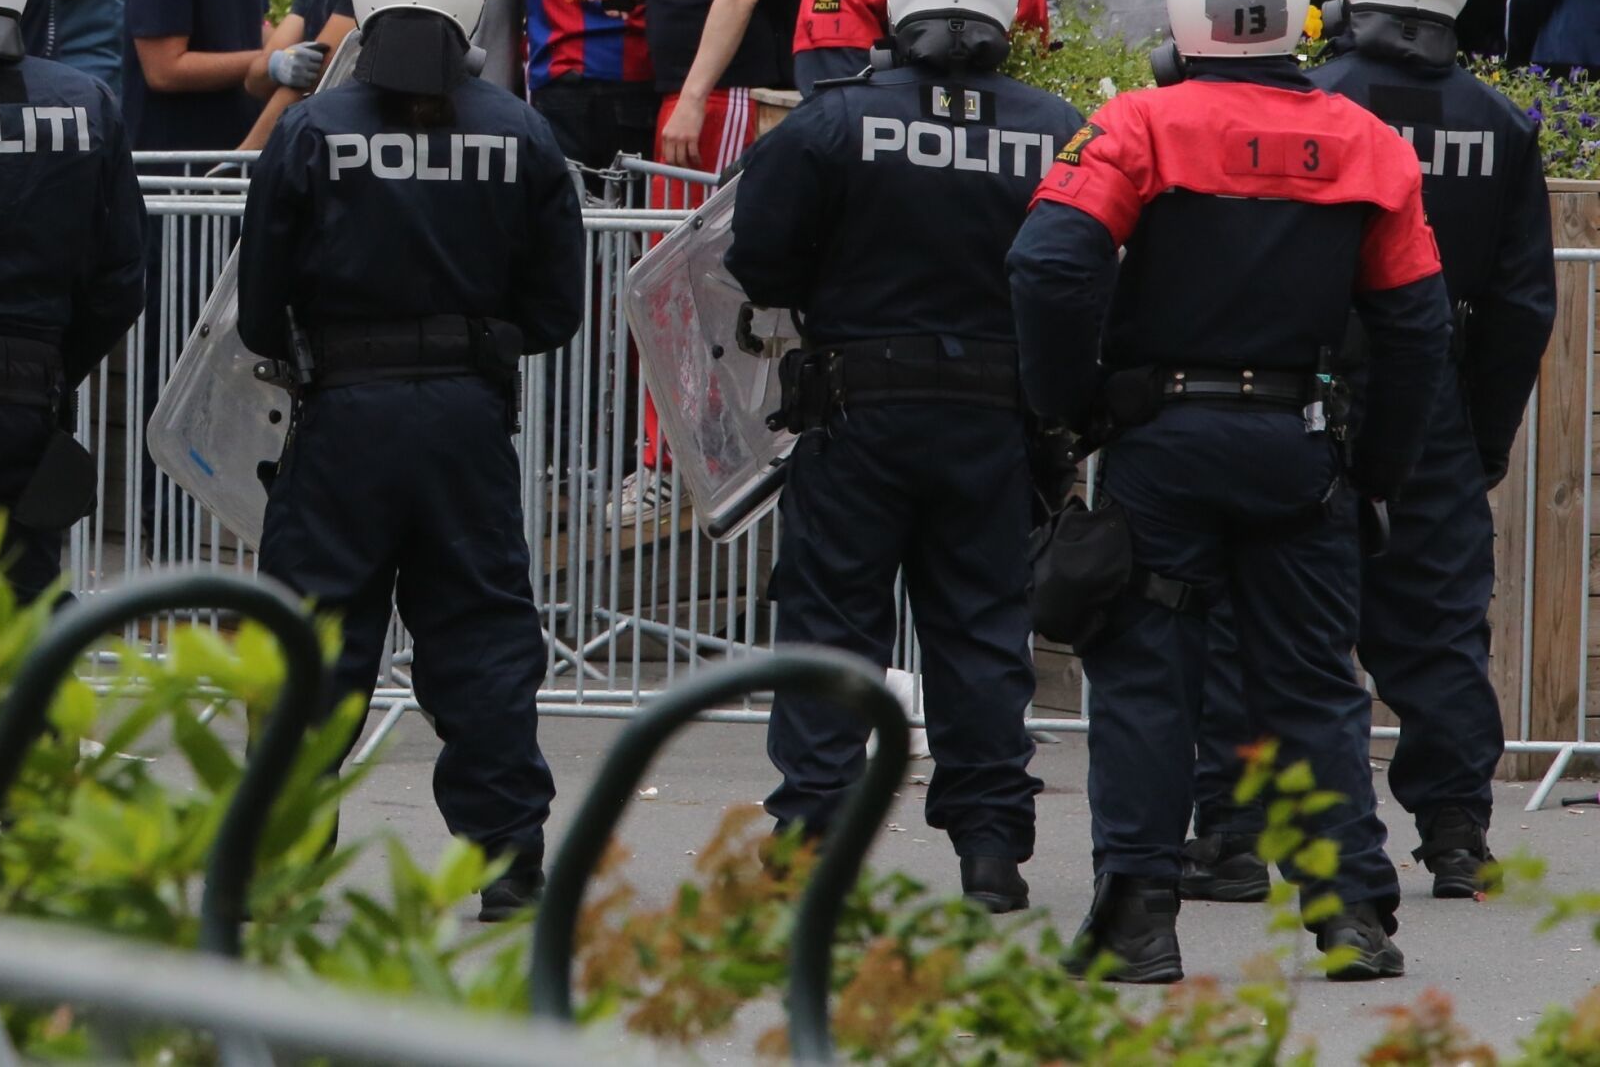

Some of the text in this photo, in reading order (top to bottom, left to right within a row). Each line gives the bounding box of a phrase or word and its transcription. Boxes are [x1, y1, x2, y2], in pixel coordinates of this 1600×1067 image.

[1234, 4, 1267, 37] 13
[939, 94, 977, 111] M1
[324, 133, 518, 183] POLITI
[861, 115, 1054, 180] POLITI
